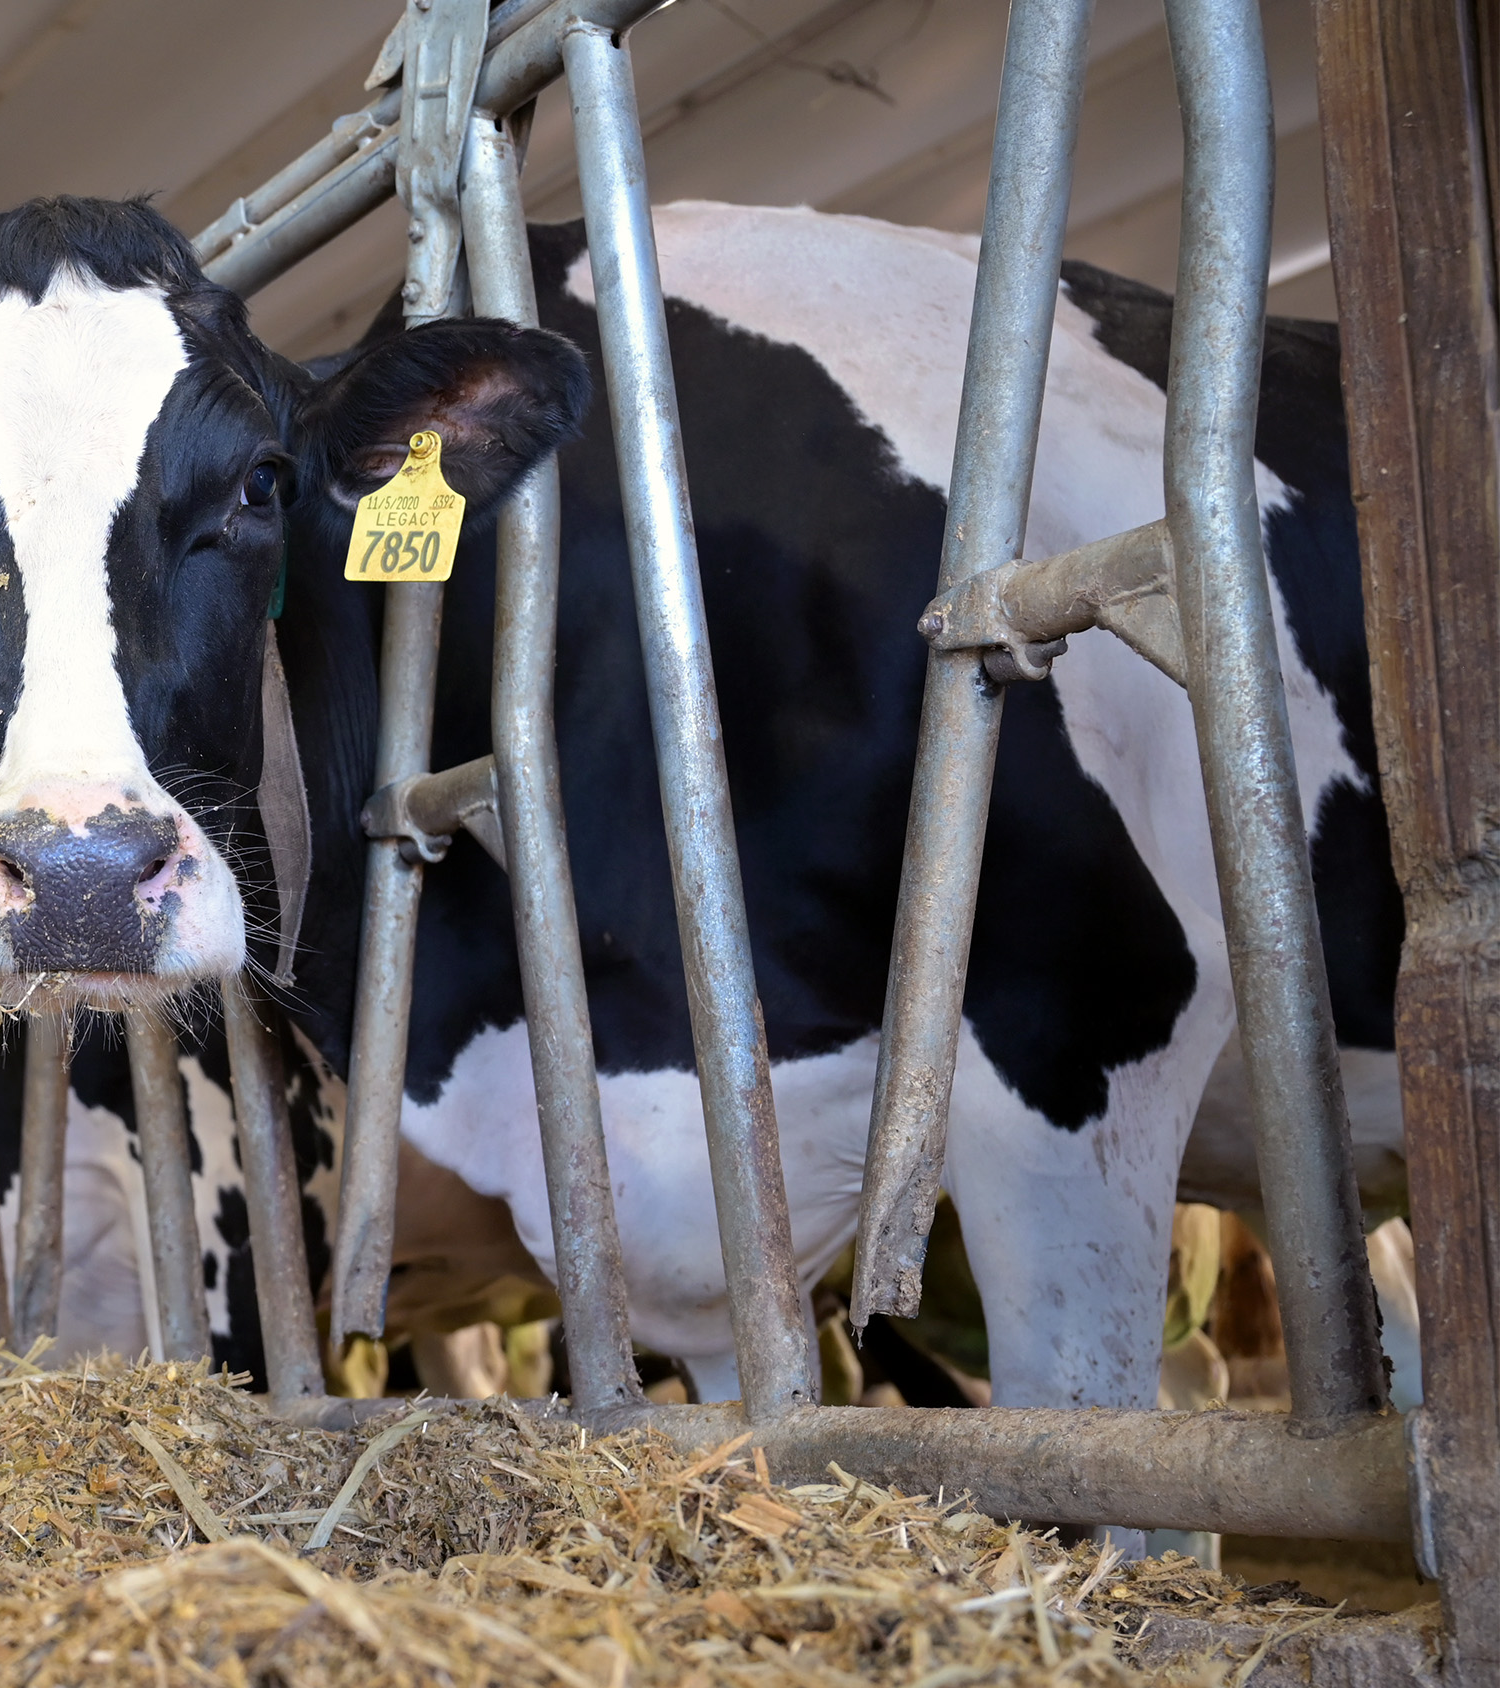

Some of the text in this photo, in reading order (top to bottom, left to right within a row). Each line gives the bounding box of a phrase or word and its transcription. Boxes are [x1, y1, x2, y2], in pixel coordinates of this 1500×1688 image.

[367, 494, 456, 510] 11/5/2020 6392
[376, 511, 441, 526] LEGACY
[359, 531, 440, 573] 7850
